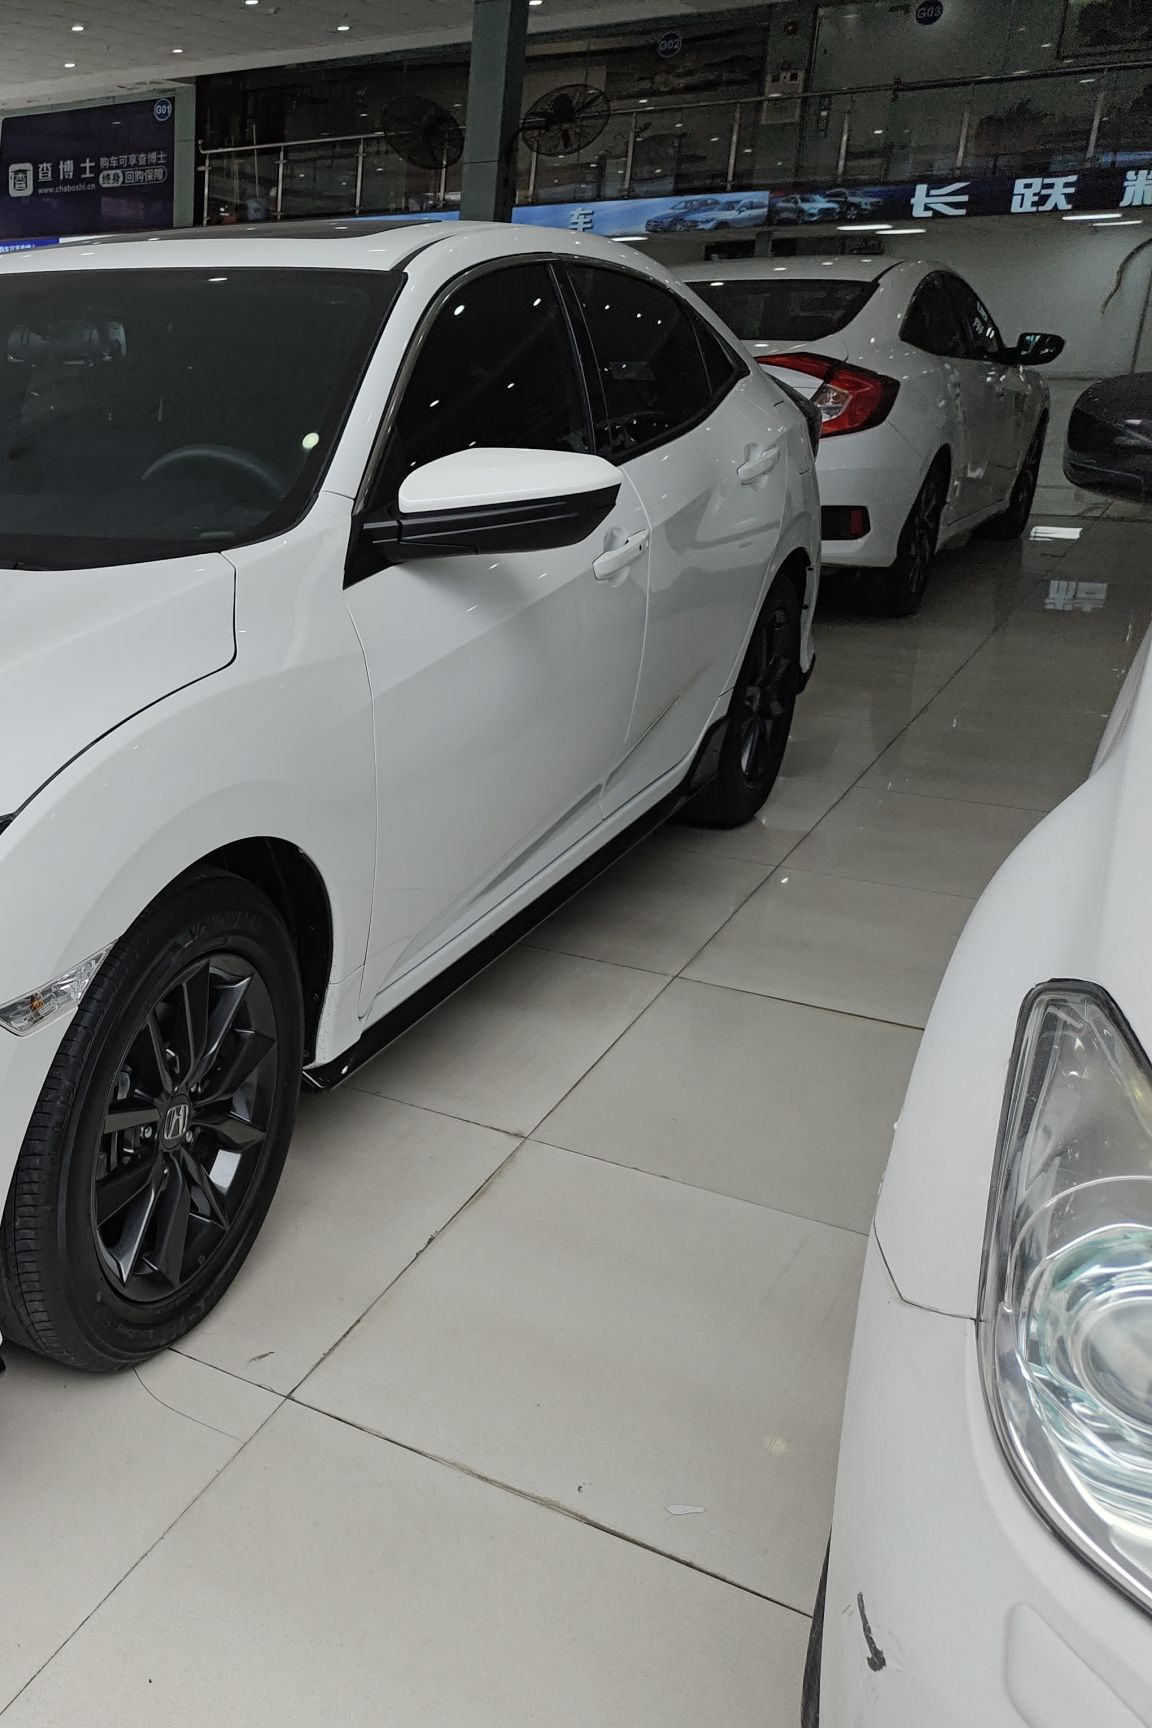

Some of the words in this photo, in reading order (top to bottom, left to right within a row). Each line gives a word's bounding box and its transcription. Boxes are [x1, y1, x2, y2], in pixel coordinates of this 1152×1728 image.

[100, 151, 168, 169] 购车可享查博士
[37, 157, 97, 182] 查博士
[101, 172, 123, 186] 终身
[125, 168, 165, 184] 回购保障
[37, 182, 97, 195] www.chaboshi.cn
